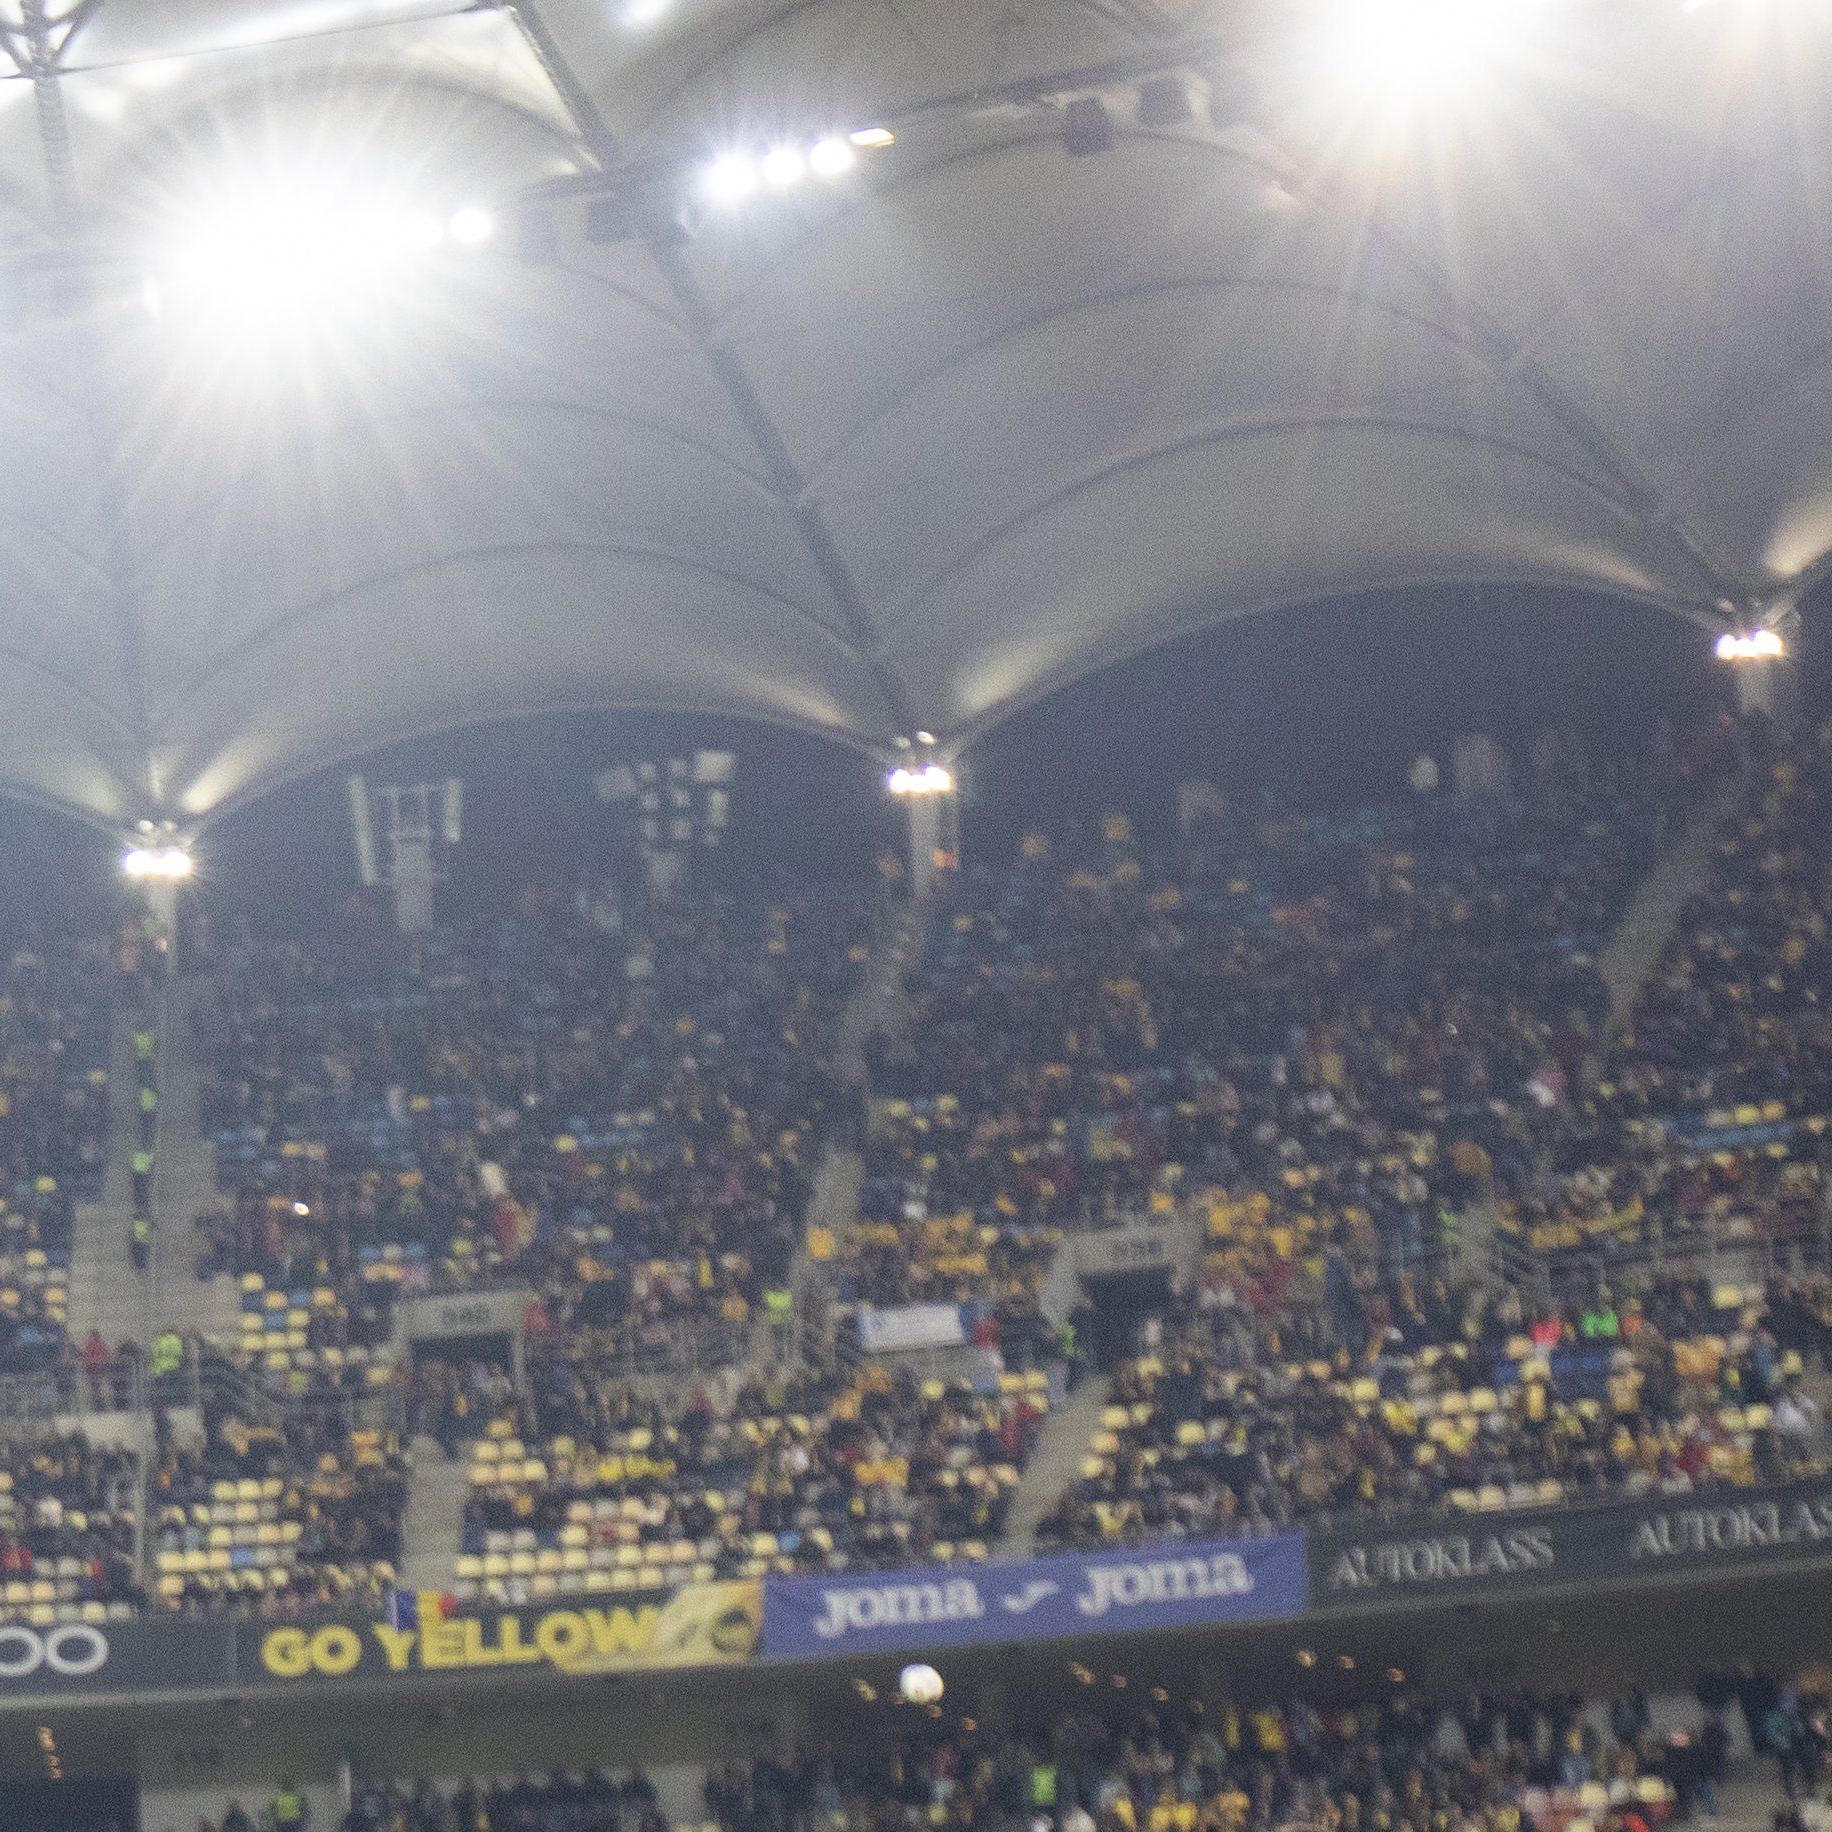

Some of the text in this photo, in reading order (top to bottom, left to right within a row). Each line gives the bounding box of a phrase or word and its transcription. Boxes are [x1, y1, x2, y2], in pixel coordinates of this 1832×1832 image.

[1337, 1527, 1555, 1587] AUTOKLASS
[261, 1605, 661, 1678] GO YELLOW
